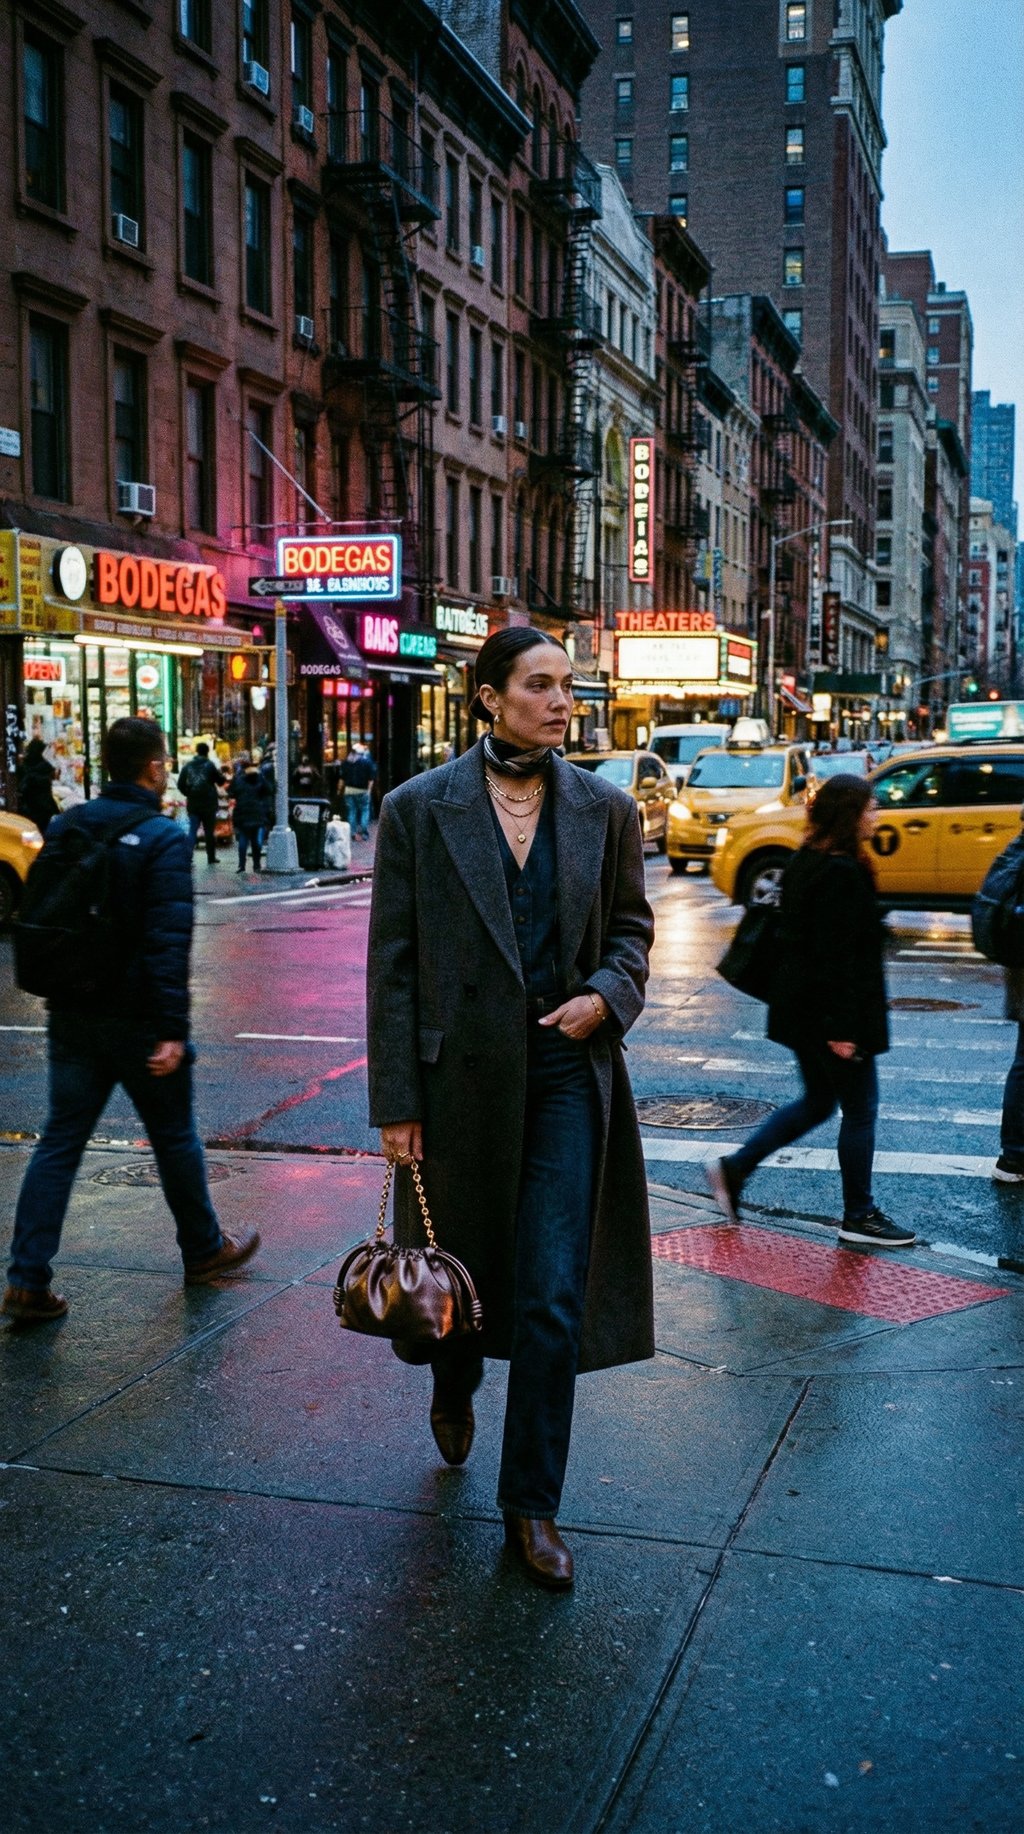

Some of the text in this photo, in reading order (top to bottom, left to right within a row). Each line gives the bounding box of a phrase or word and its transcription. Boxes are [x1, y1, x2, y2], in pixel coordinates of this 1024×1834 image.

[284, 544, 392, 574] BODEGAS
[97, 552, 227, 620] BODEGAS
[615, 611, 716, 631] THEATERS
[364, 615, 399, 654] BARS
[24, 661, 61, 681] OPEN
[300, 664, 341, 676] BODEGAS
